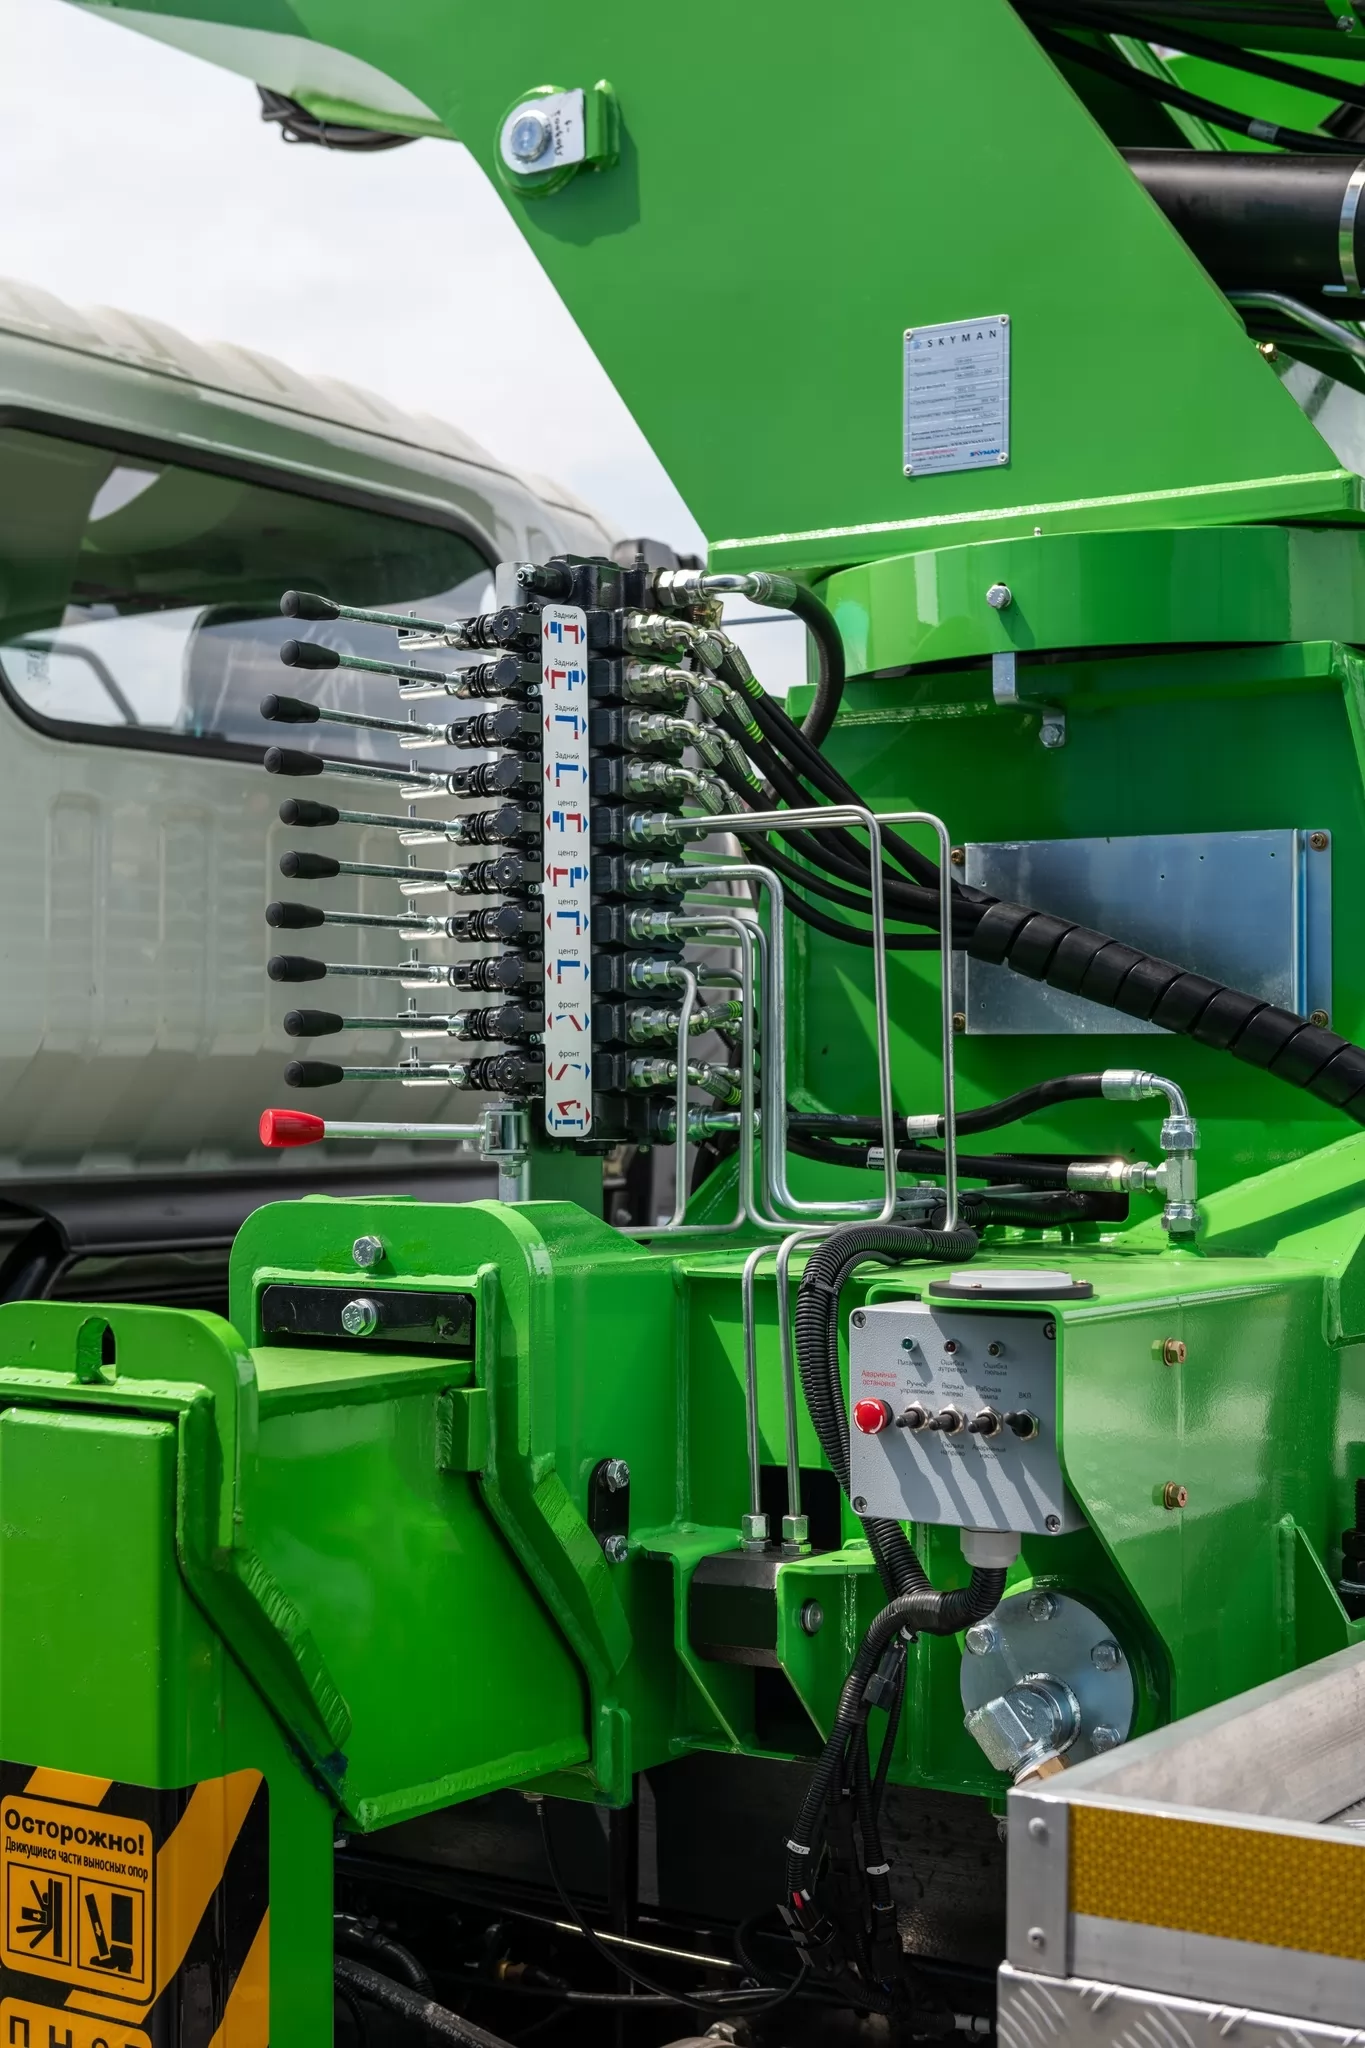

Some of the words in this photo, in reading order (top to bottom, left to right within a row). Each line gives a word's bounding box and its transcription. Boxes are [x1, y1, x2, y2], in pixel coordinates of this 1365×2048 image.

[927, 330, 997, 348] SKYMAN
[553, 610, 578, 620] Задний
[554, 658, 578, 667] Задний
[554, 703, 579, 712] Задний
[555, 751, 580, 760] Задний
[557, 800, 578, 808] центр
[558, 948, 579, 956] центр
[558, 1001, 580, 1009] фронт
[558, 1050, 580, 1059] фронт
[4, 1808, 145, 1857] Осторожно!
[5, 1836, 57, 1859] Движущиеся
[58, 1850, 82, 1866] части
[83, 1855, 127, 1875] выносных
[127, 1865, 149, 1884] опор
